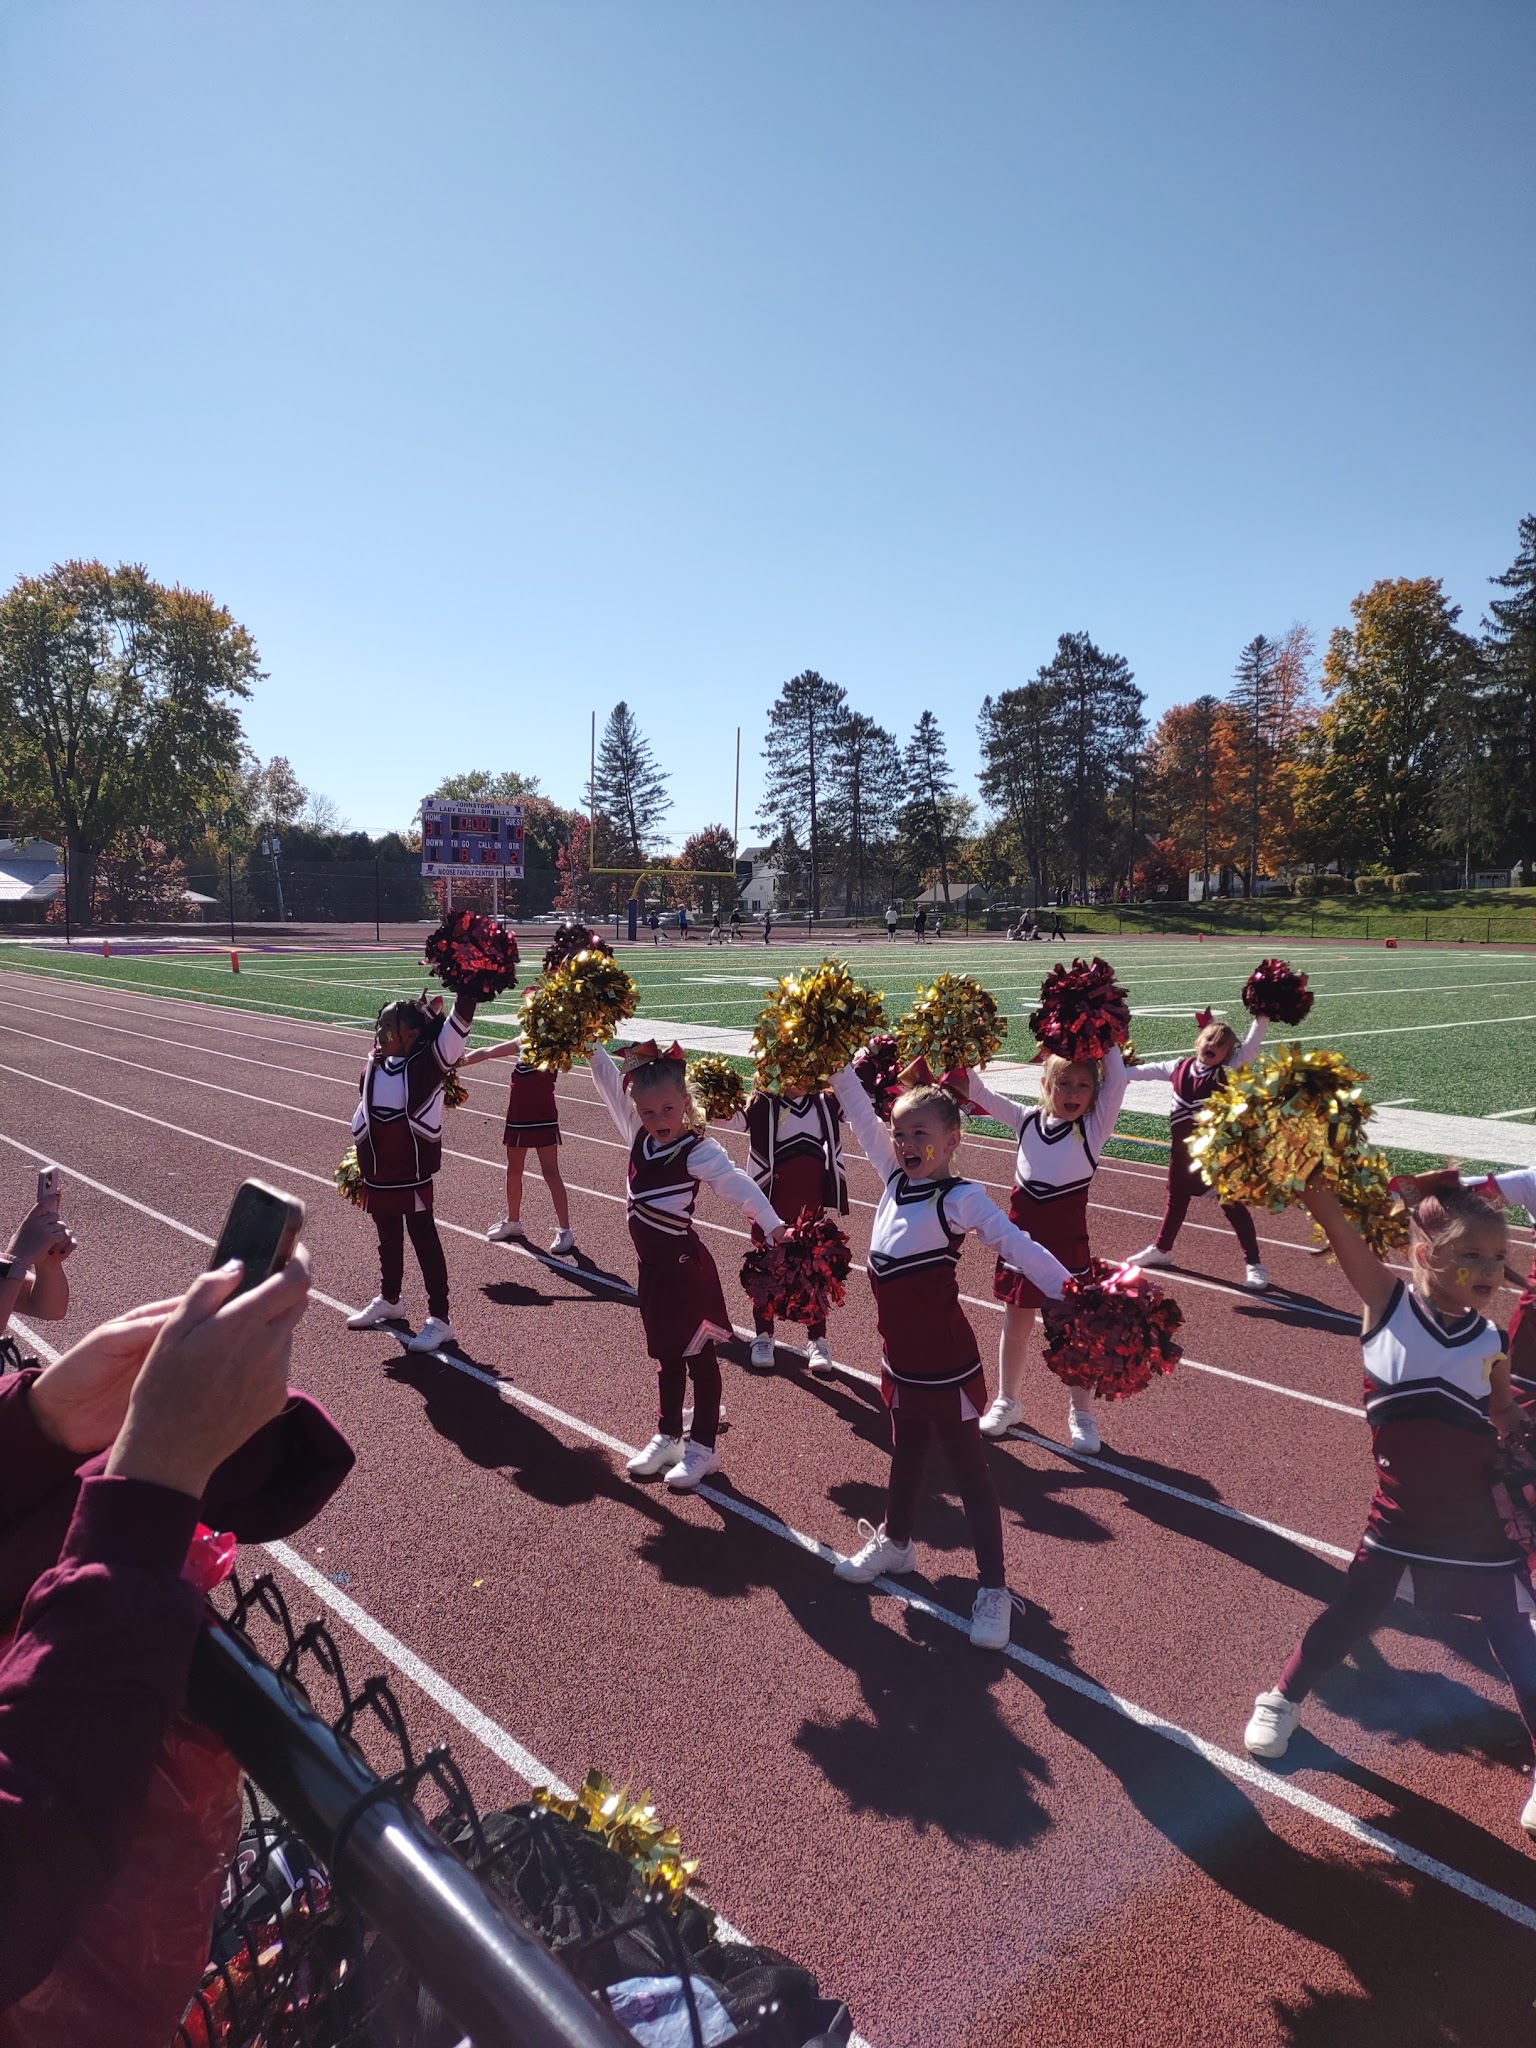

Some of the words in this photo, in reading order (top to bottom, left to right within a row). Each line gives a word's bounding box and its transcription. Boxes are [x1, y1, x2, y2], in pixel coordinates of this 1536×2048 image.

[455, 801, 495, 809] JOHNSTOWN
[425, 813, 442, 822] HOME
[505, 818, 524, 826] GUEST
[425, 838, 444, 847] DOWN
[450, 840, 459, 848] TO
[461, 840, 470, 848] GO
[493, 842, 502, 850] ON
[508, 842, 520, 850] QTR
[437, 868, 455, 876] MOOSE
[456, 869, 474, 877] FAMILY
[475, 869, 494, 877] CENTER
